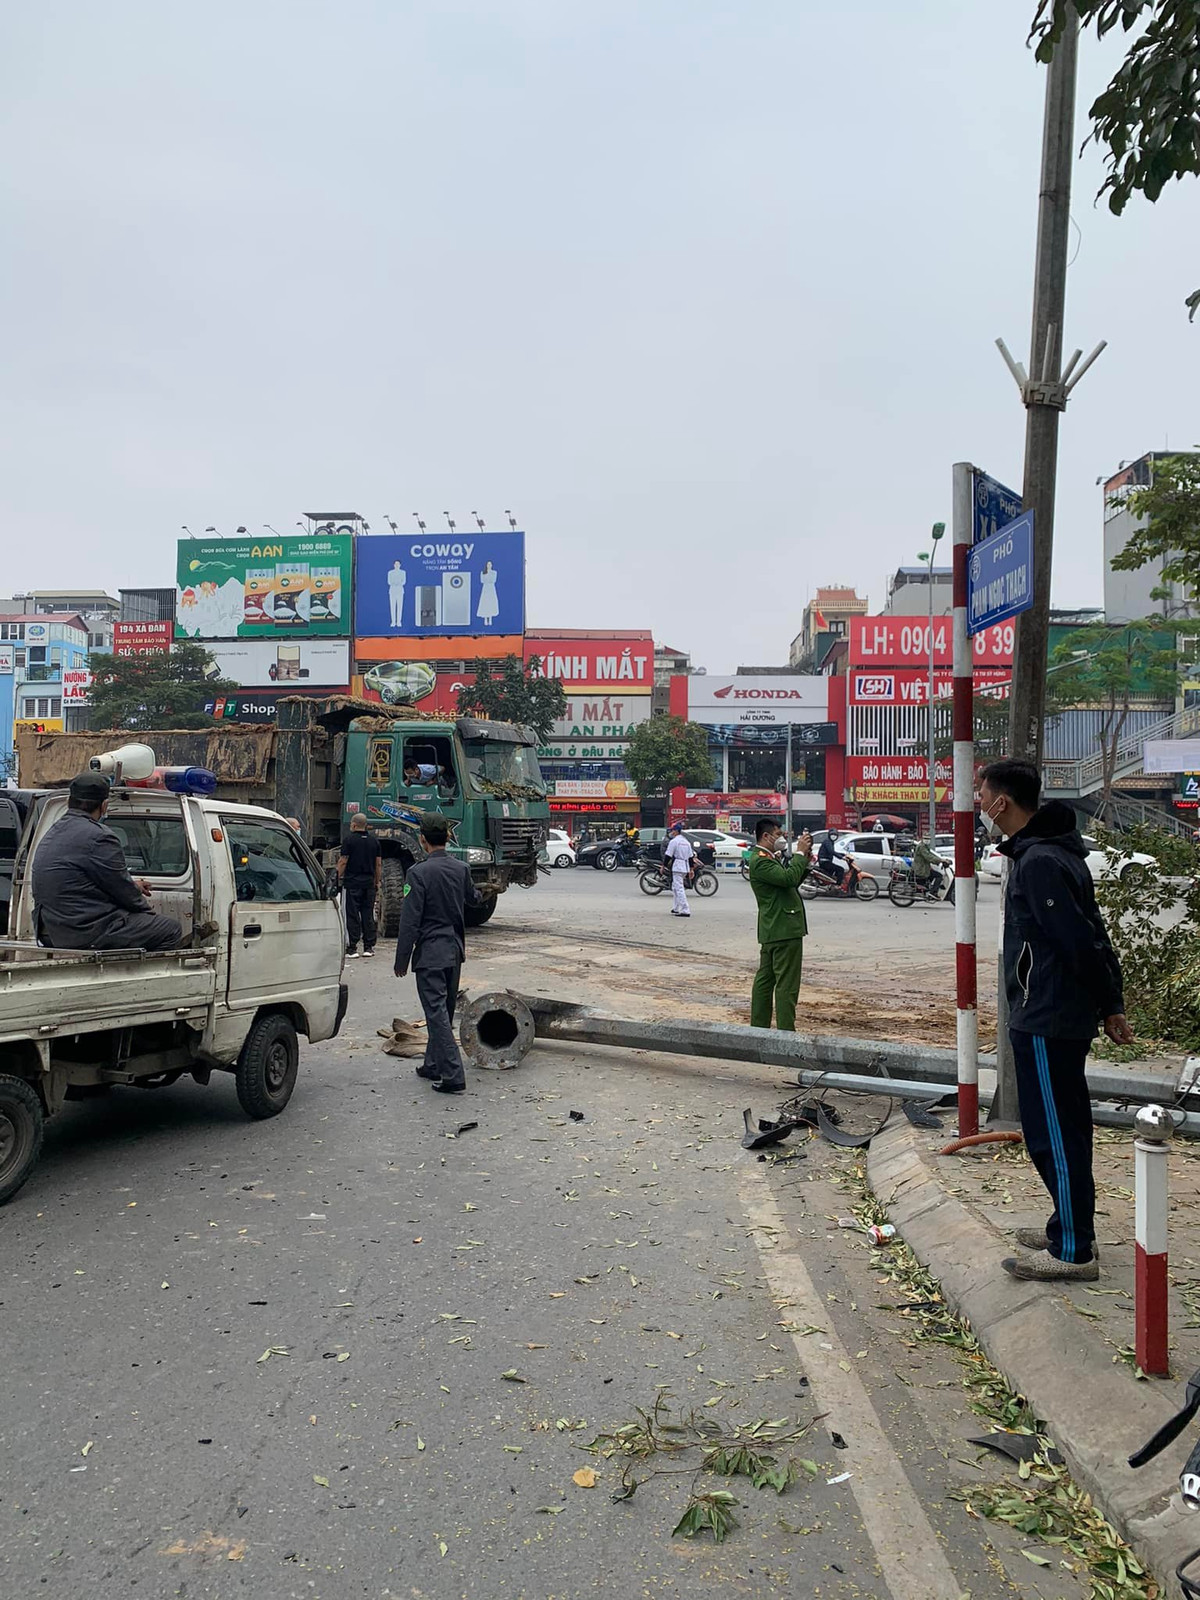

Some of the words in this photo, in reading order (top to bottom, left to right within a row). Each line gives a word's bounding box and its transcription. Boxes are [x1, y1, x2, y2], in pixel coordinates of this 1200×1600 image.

[1000, 498, 1017, 518] PHỐ
[251, 545, 282, 558] AAN
[410, 543, 474, 560] coway
[993, 531, 1014, 564] PHỐ
[972, 585, 988, 621] PHẠM
[988, 576, 1005, 612] NGỌC
[1005, 563, 1027, 604] THẠCH
[119, 625, 133, 633] 194
[861, 626, 894, 655] LH:
[901, 626, 946, 655] 0904
[531, 651, 587, 680] KÍNH
[596, 647, 647, 680] MẮT
[734, 689, 801, 699] HONDA
[865, 679, 885, 694] SH
[204, 701, 237, 714] FPT
[583, 697, 624, 721] MẮT
[570, 726, 594, 736] AN
[602, 722, 637, 736] PHÁ
[537, 746, 562, 757] ÔNG
[863, 761, 879, 779] BẢO
[881, 763, 903, 779] HÀNH
[908, 761, 924, 779] BẢO
[872, 790, 898, 800] KHÁCH
[900, 791, 919, 800] THAY
